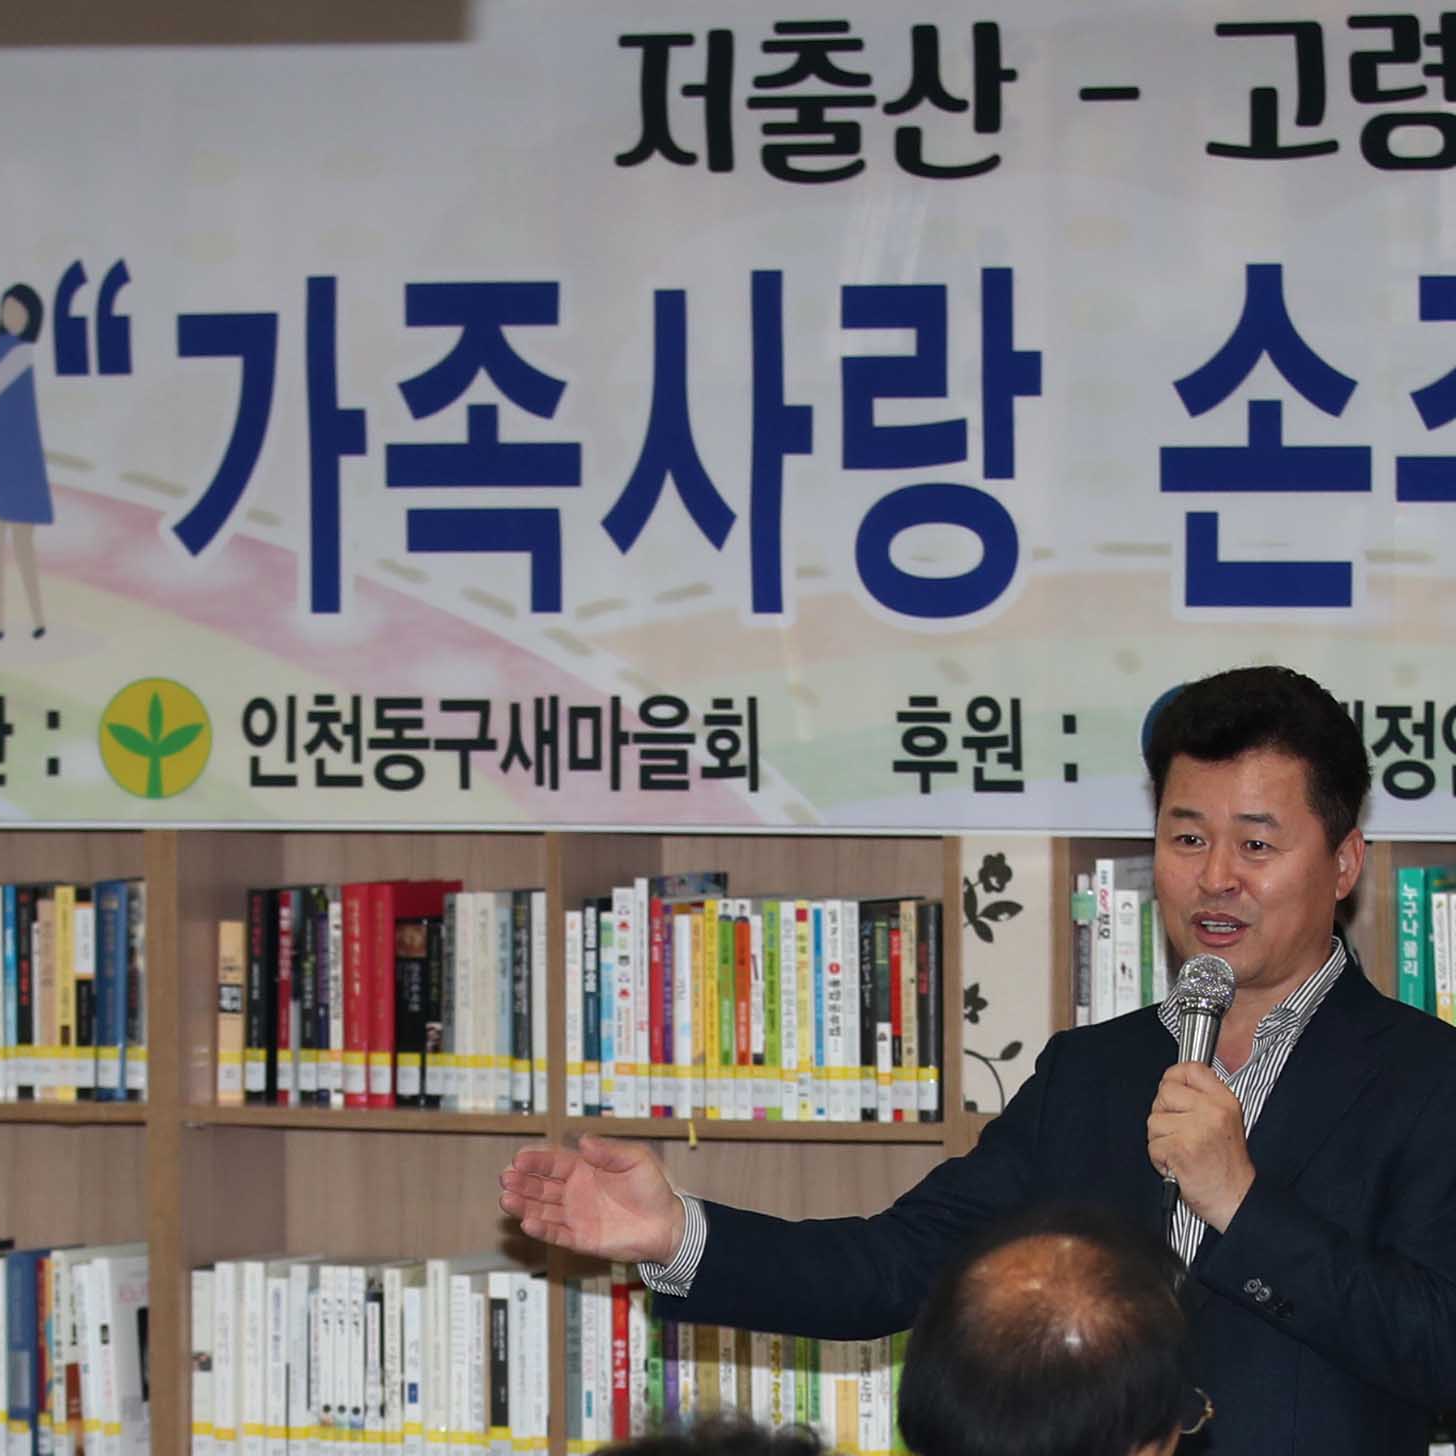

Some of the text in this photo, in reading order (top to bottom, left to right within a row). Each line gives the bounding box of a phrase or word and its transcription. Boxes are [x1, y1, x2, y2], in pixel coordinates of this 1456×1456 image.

[614, 18, 1020, 186] 저출산
[241, 693, 760, 794] 인천동구새마을회
[891, 695, 1026, 795] 후원
